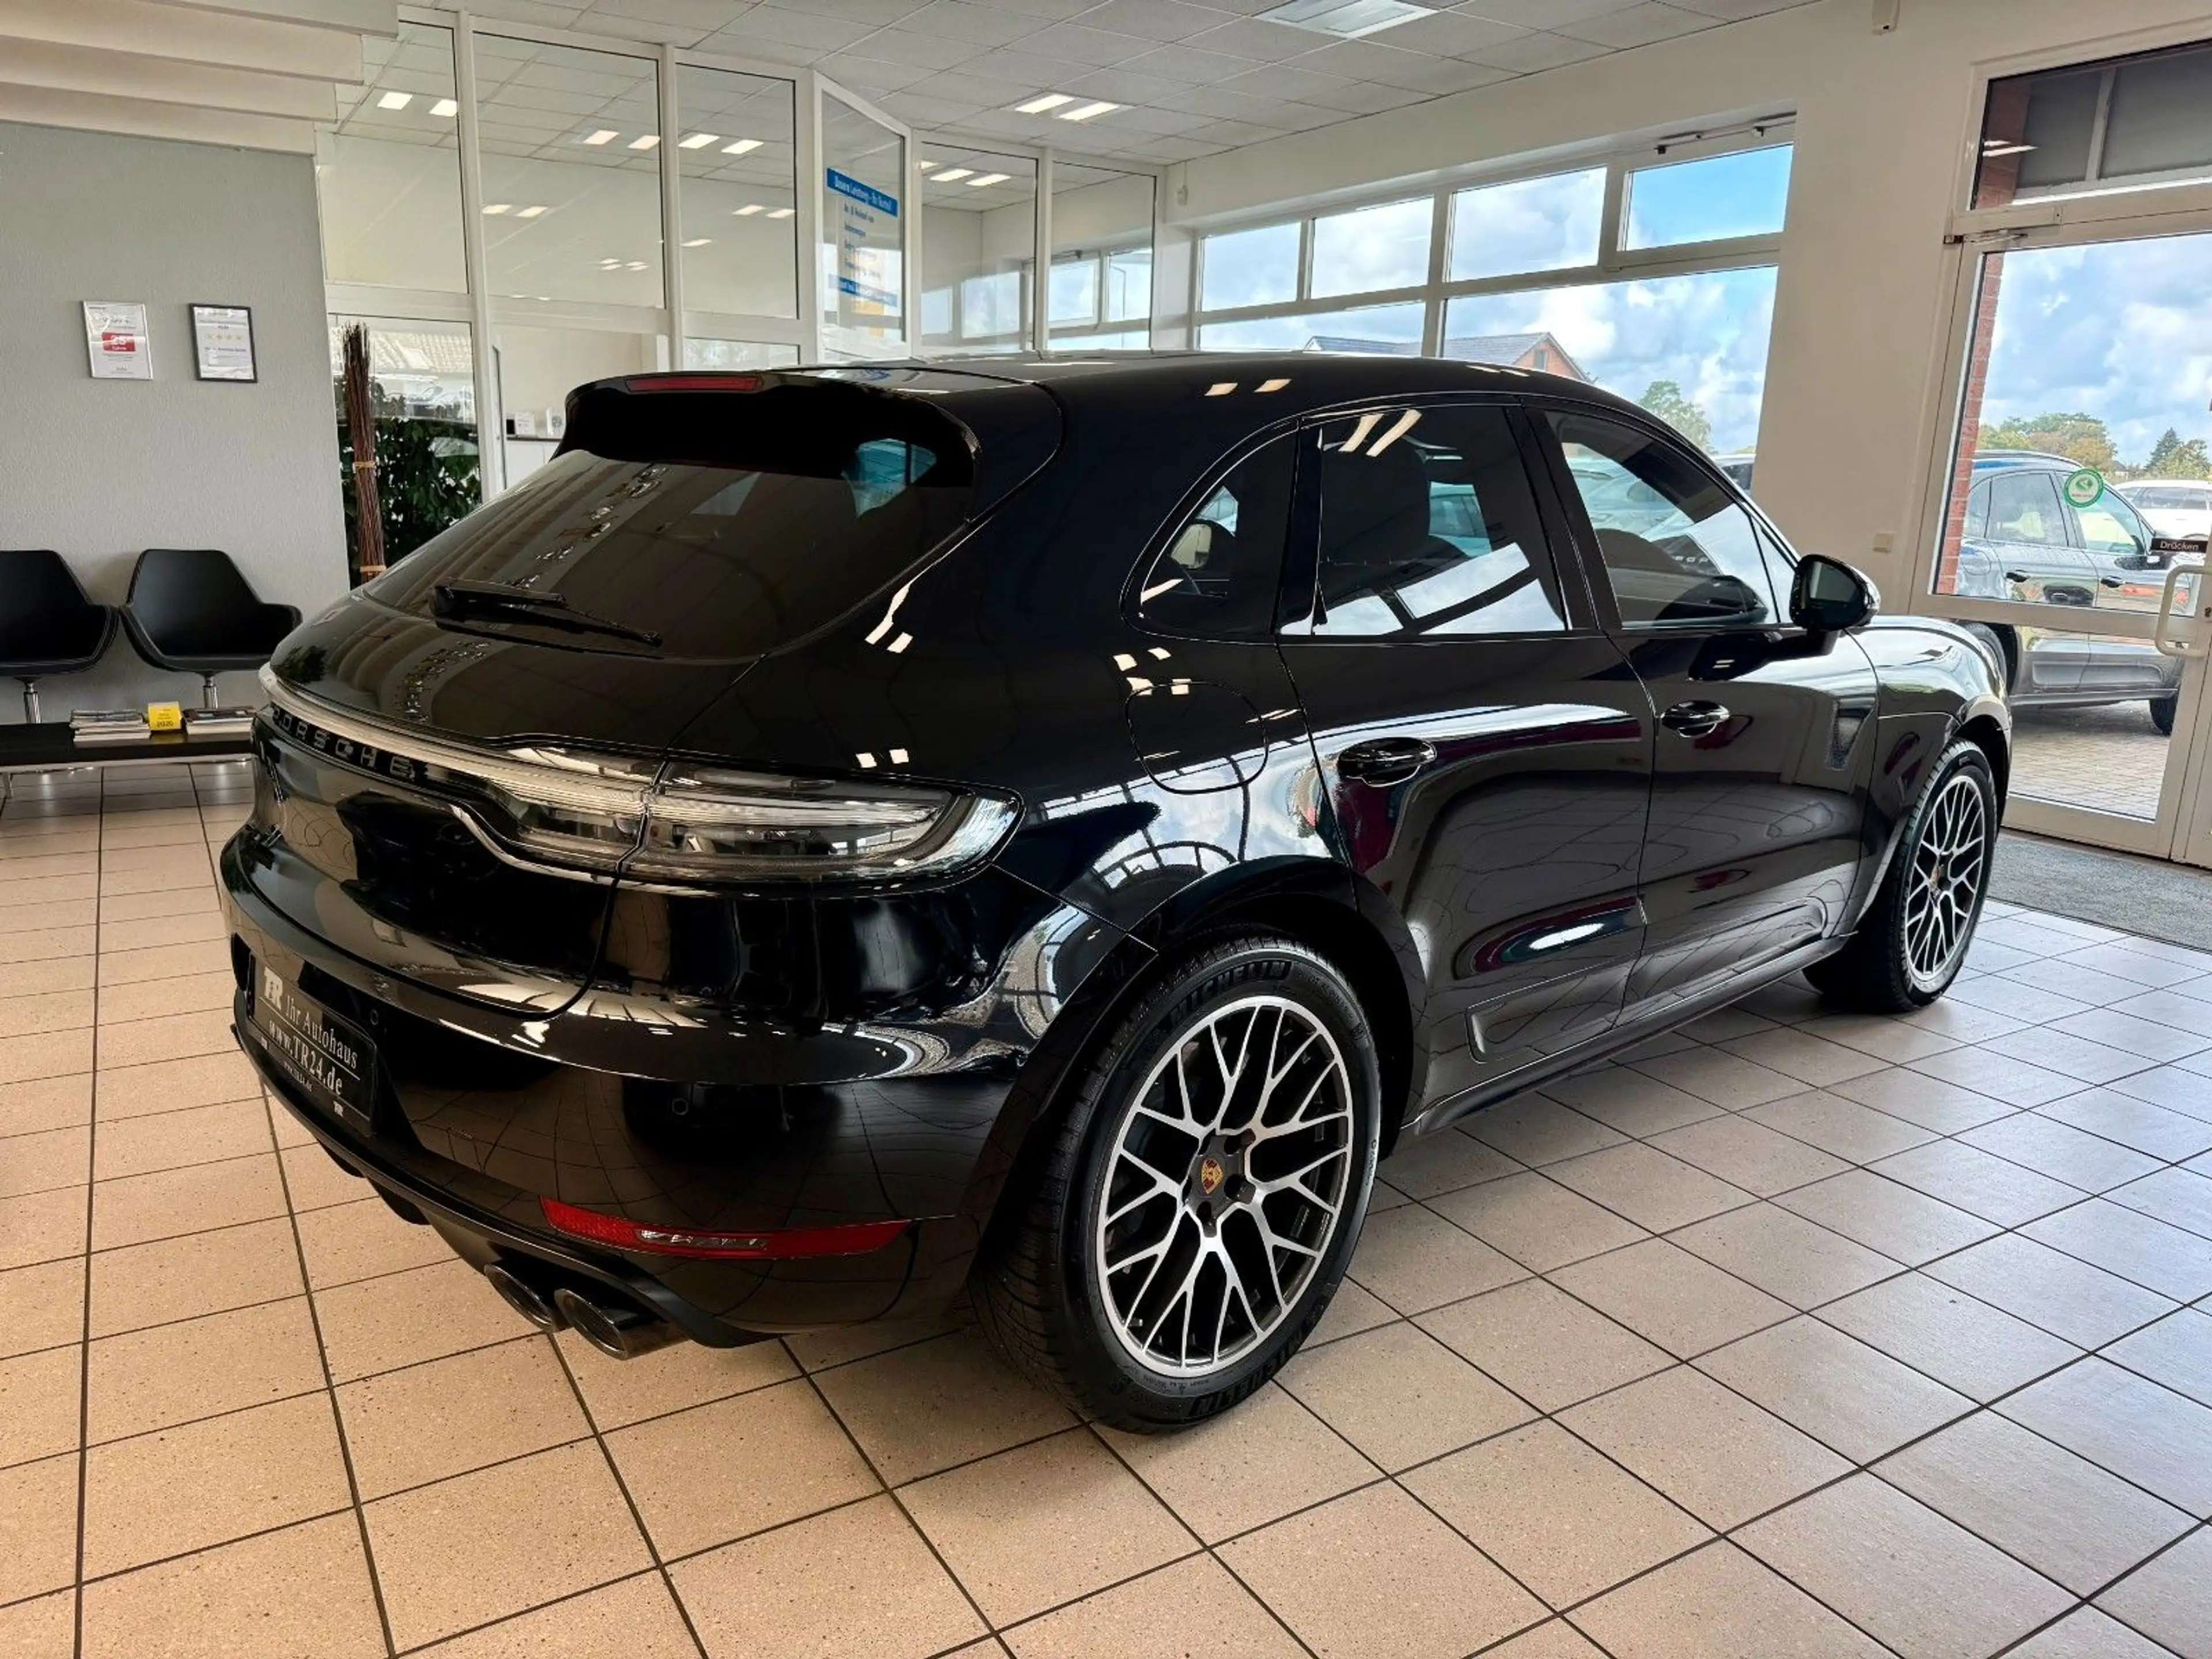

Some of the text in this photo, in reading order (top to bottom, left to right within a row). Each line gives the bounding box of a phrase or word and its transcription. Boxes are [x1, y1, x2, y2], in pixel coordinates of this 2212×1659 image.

[2160, 540, 2199, 551] Drücken
[270, 1020, 343, 1095] www.TR24.de
[286, 995, 301, 1025] Ihr
[303, 1012, 358, 1070] Autohaus
